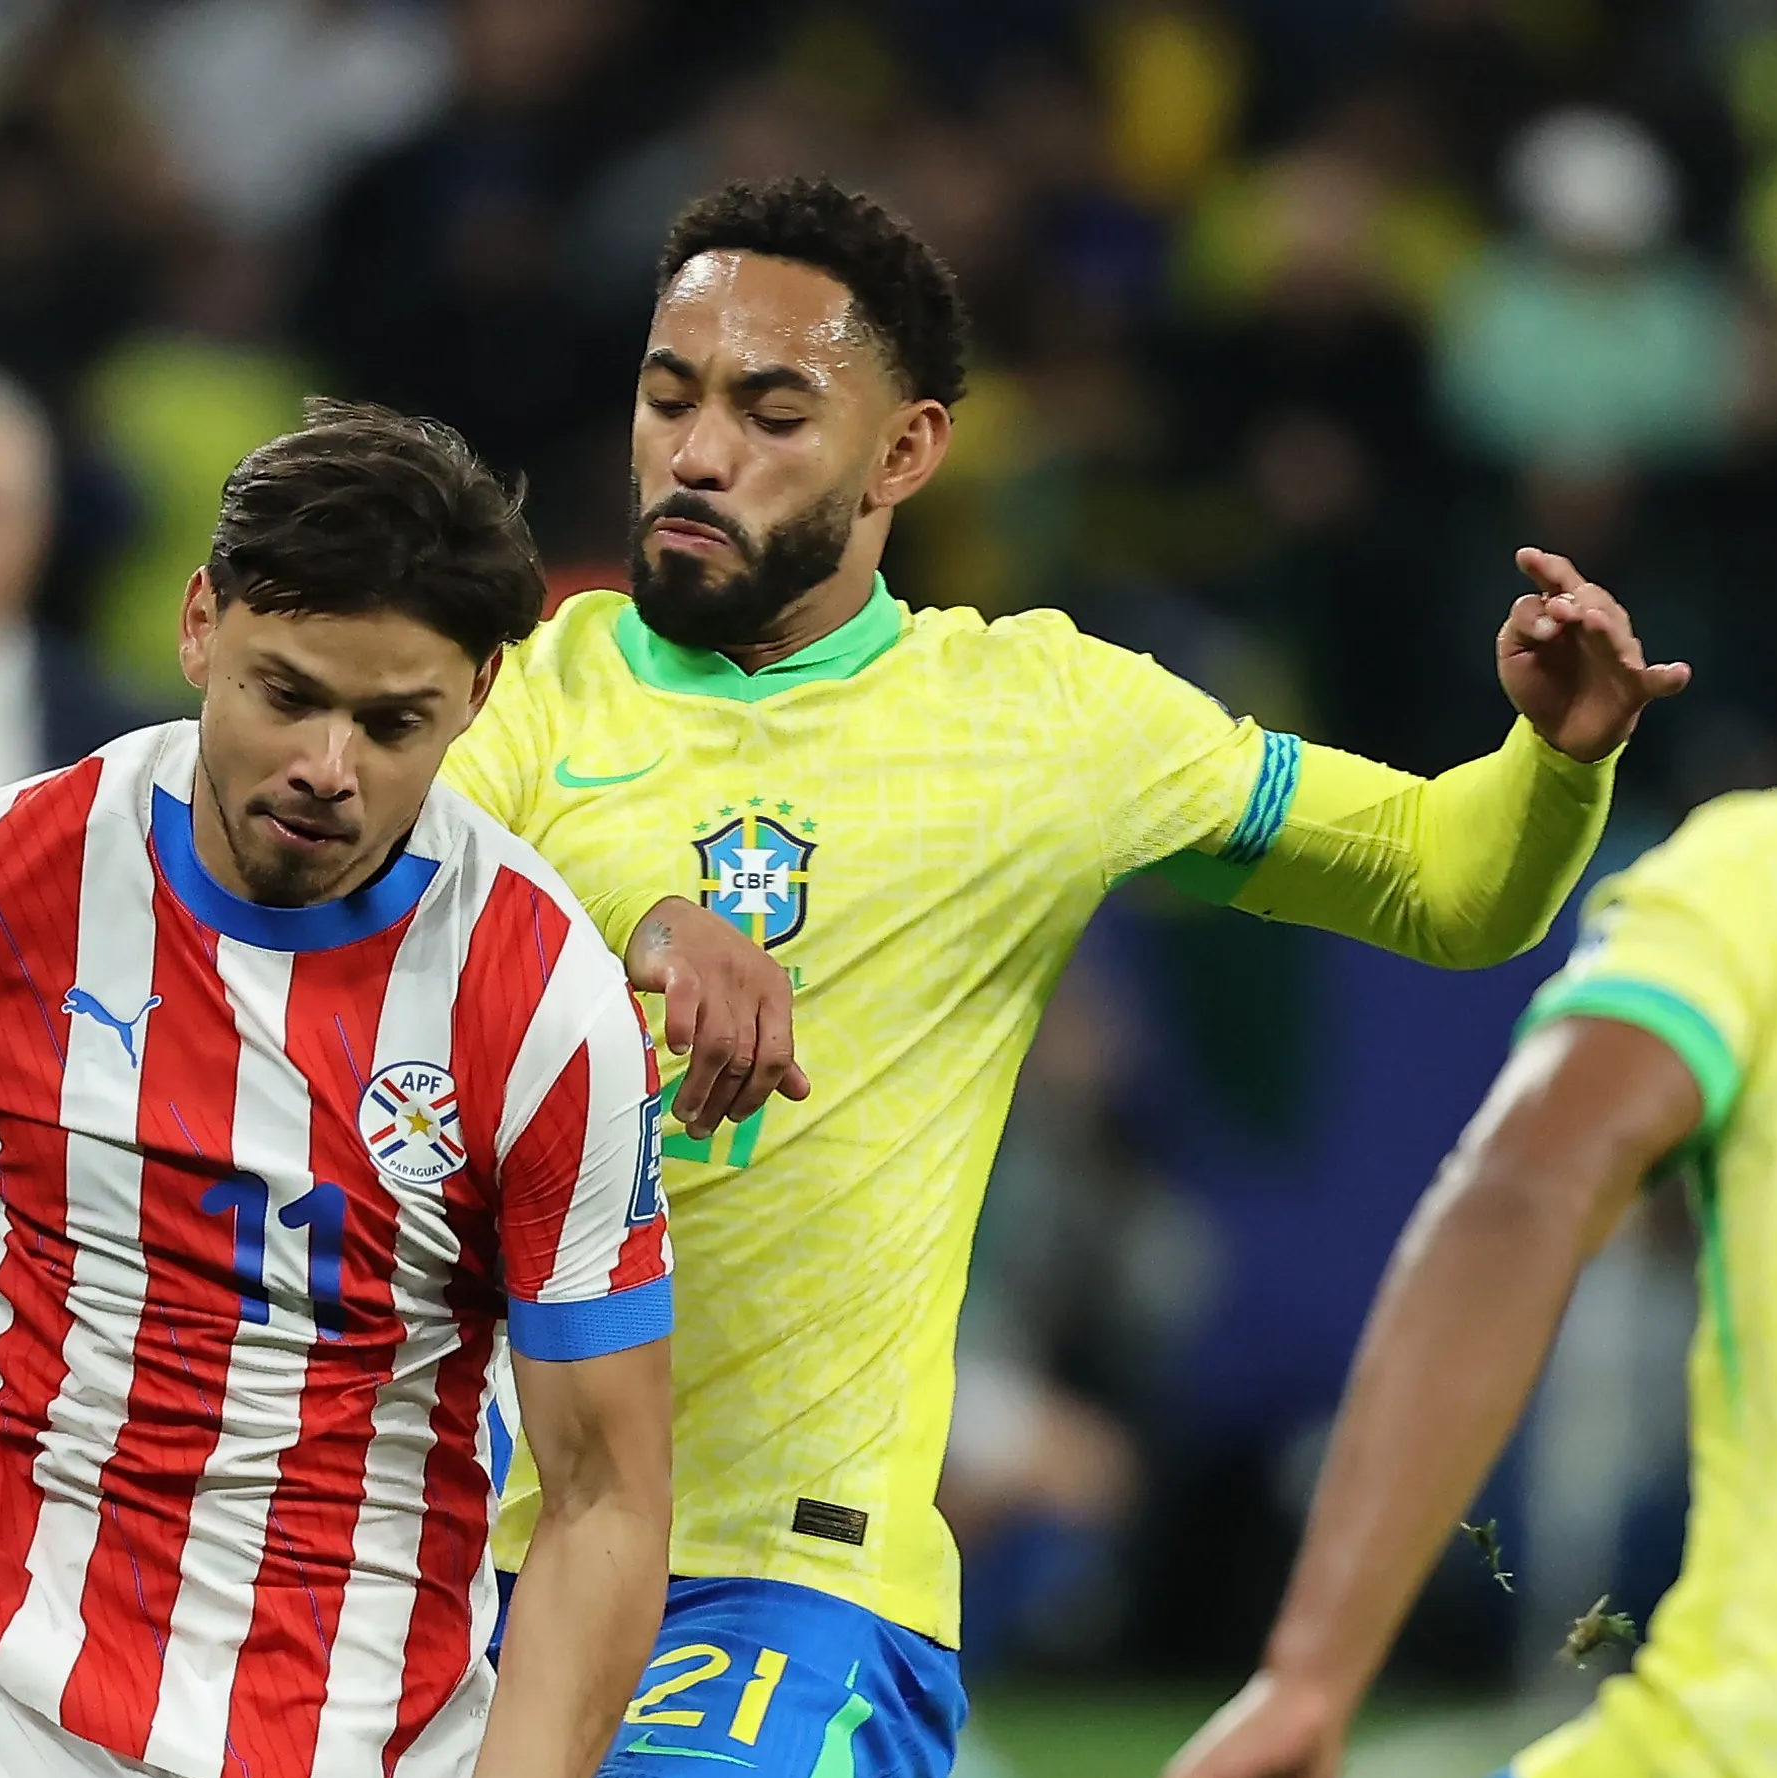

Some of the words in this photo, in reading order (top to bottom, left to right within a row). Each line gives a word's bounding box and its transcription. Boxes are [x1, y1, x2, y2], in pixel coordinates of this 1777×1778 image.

[733, 873, 775, 889] CBF
[400, 1071, 442, 1094] APF
[388, 1160, 444, 1177] PARAGUAY
[200, 1172, 348, 1341] 11
[623, 1643, 790, 1746] 21
